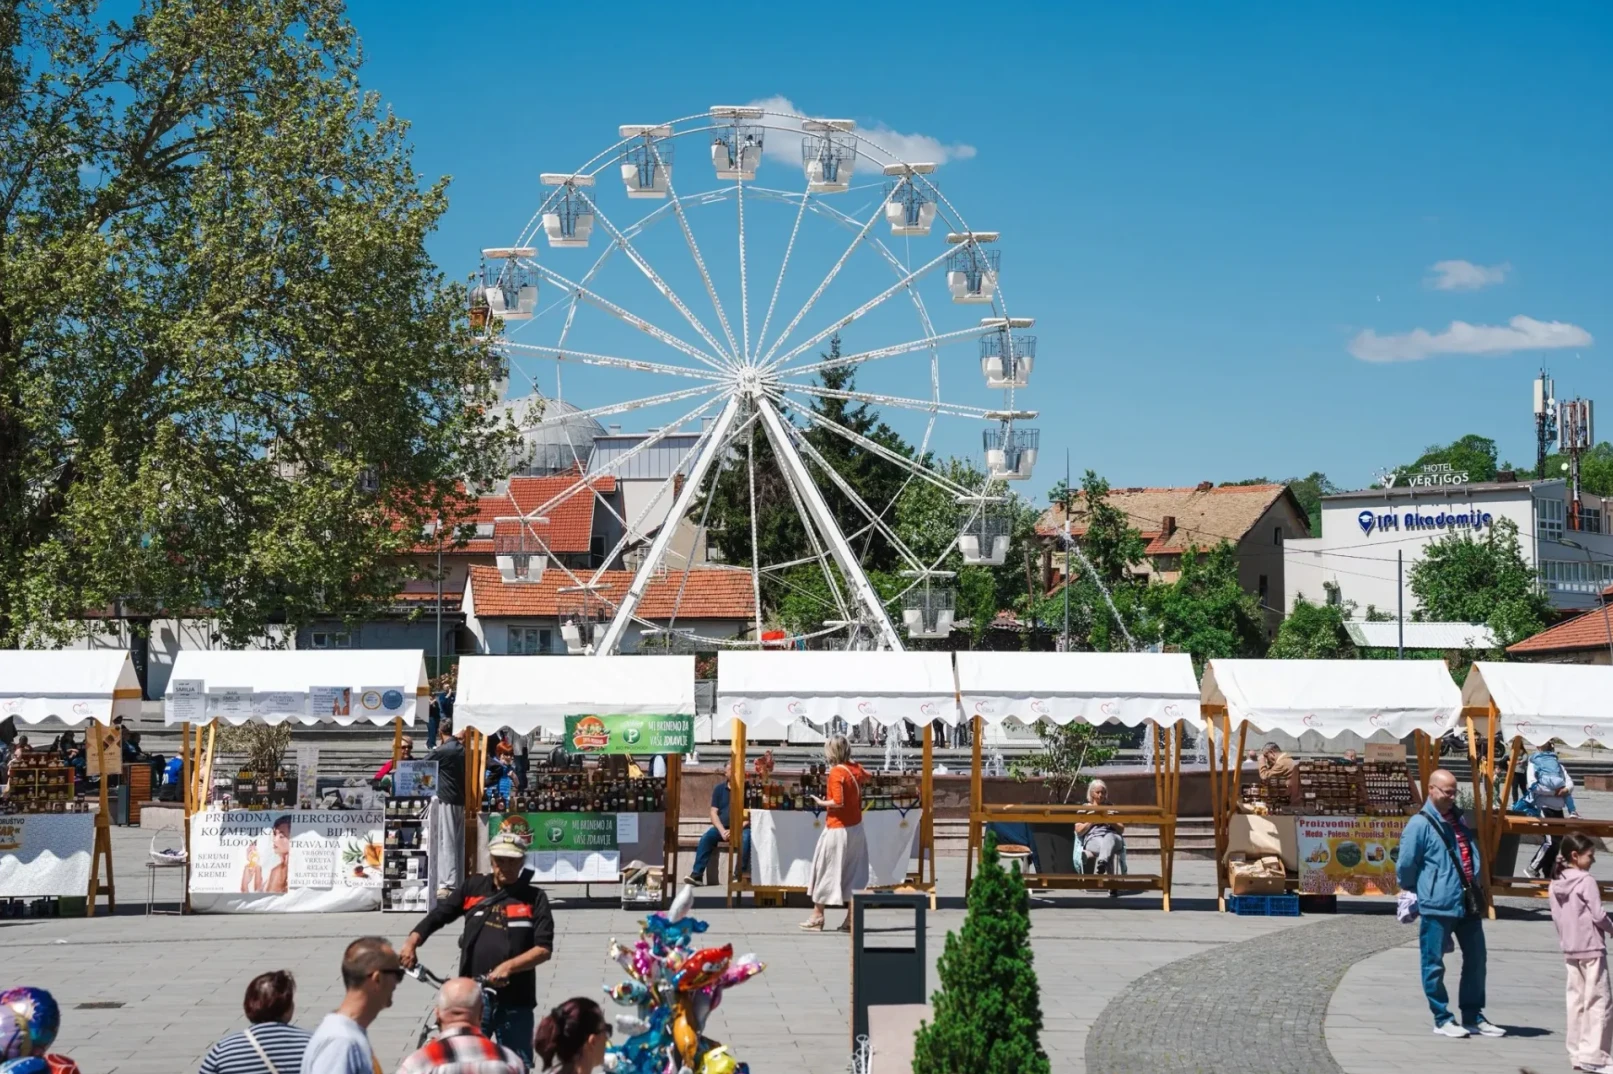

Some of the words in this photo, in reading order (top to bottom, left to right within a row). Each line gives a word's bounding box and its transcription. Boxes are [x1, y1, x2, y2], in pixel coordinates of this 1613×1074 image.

[1423, 463, 1454, 472] HOTEL
[1408, 472, 1469, 487] VERTIGOS
[1378, 513, 1398, 529] IPI
[1404, 509, 1492, 528] Akademije
[205, 813, 271, 823] PRIRODNA
[1299, 819, 1361, 829] Proizvodnja
[201, 827, 276, 837] KOZMETIKA
[326, 828, 358, 838] BILJE
[1305, 830, 1323, 838] Meda
[1328, 830, 1350, 838] Polena
[1355, 830, 1385, 839] Propolisa
[219, 839, 258, 847] BLOOM
[290, 840, 321, 848] TRAVA
[324, 840, 341, 848] IVA
